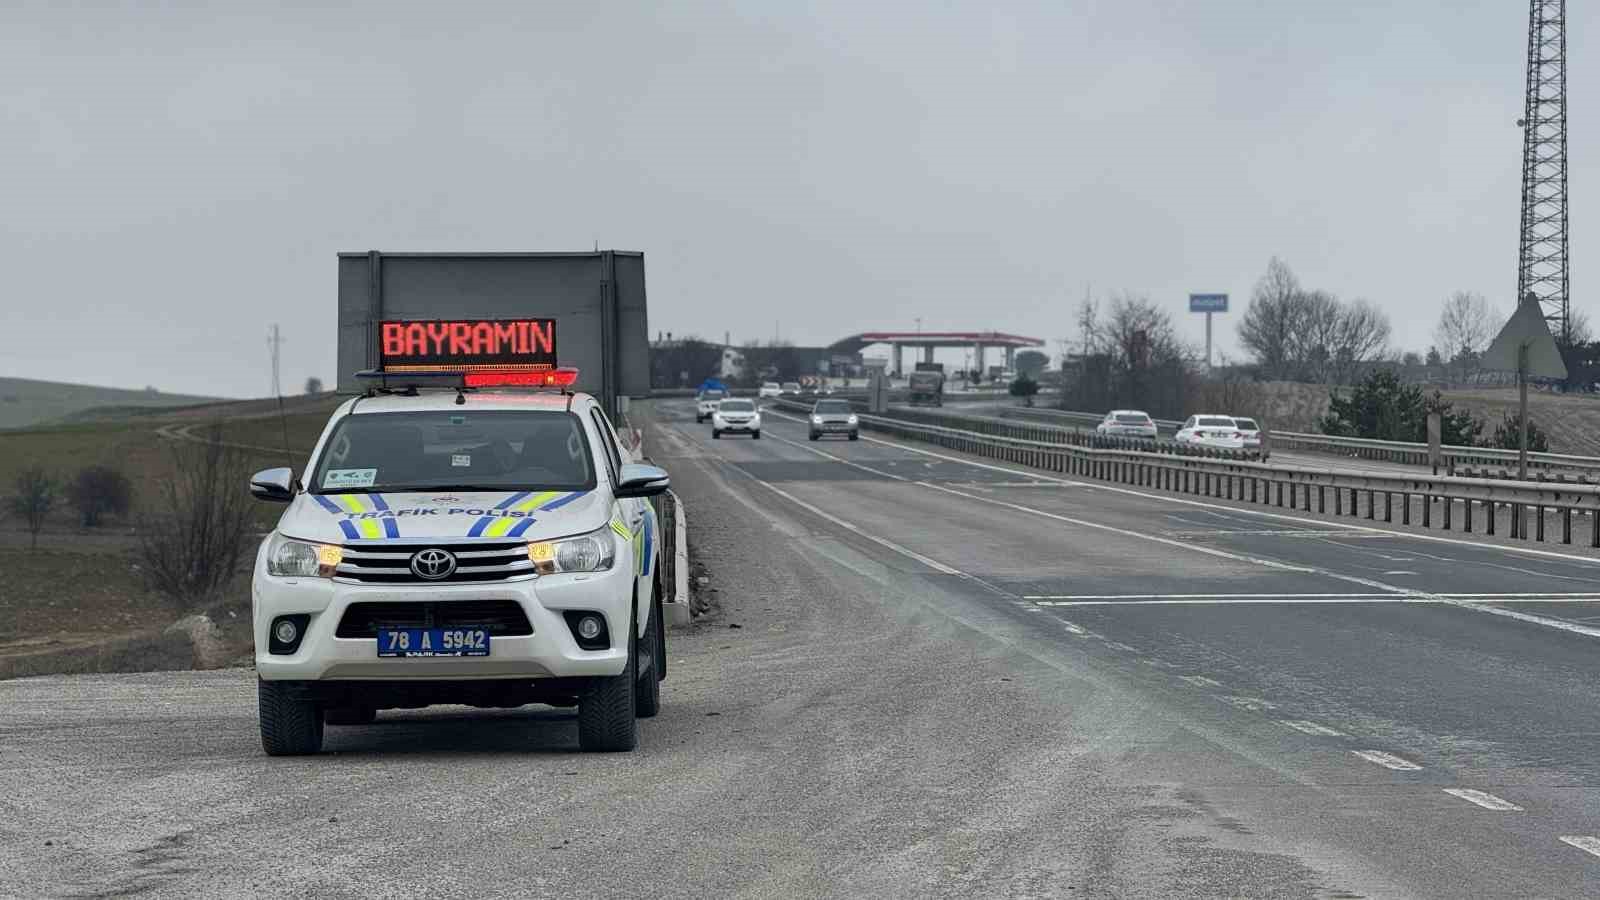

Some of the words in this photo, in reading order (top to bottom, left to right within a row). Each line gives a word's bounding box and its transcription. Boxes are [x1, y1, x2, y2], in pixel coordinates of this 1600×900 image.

[383, 322, 553, 355] BAYRAMIN
[388, 631, 410, 650] 78
[421, 631, 431, 649] A
[443, 630, 485, 649] 5942
